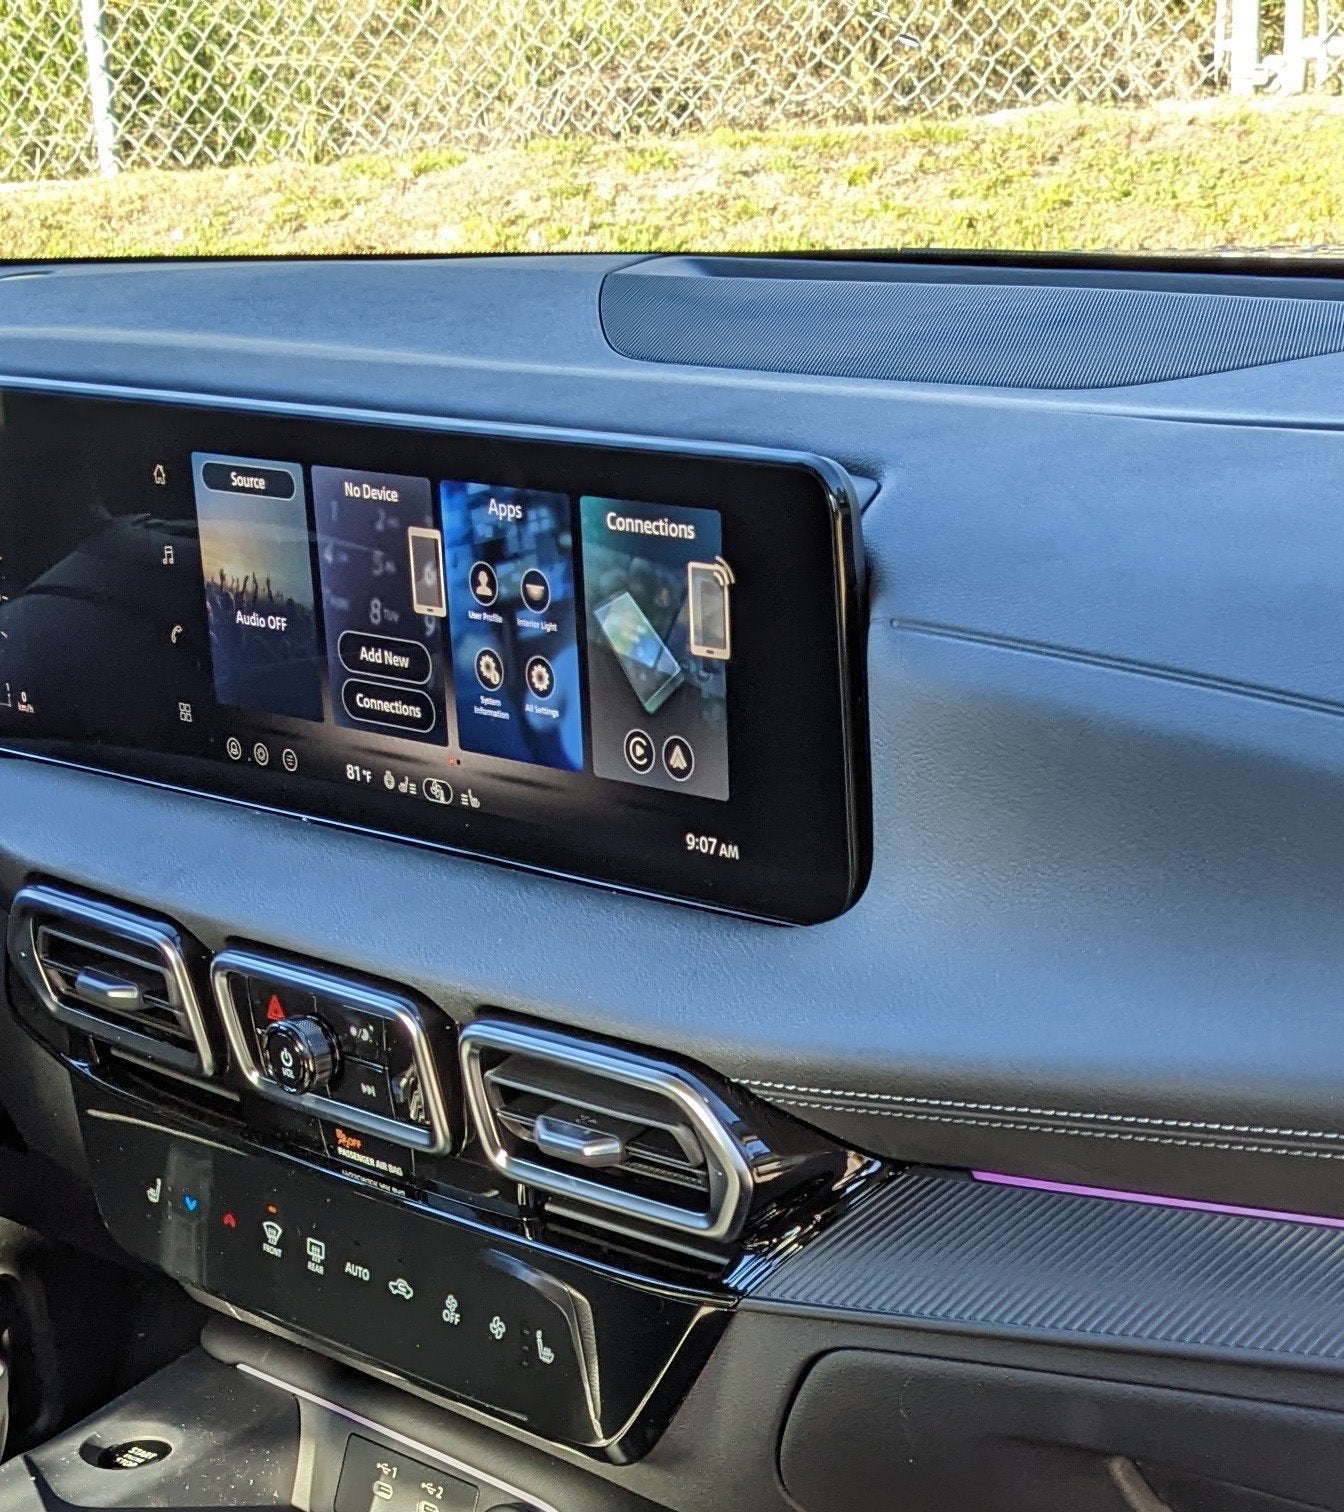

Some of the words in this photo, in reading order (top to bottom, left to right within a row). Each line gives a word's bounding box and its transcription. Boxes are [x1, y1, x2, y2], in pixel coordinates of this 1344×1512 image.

[230, 471, 266, 490] Source
[344, 482, 361, 498] No
[362, 483, 399, 503] Device
[488, 498, 523, 522] Apps
[606, 511, 697, 540] Connections
[236, 610, 266, 628] Audio
[267, 615, 288, 632] OFF
[468, 610, 482, 621] User
[483, 612, 503, 624] Profile
[516, 618, 539, 630] Interior
[540, 621, 558, 633] Light
[360, 646, 382, 664] Add
[384, 650, 410, 669] New
[356, 693, 423, 719] Connections
[480, 695, 502, 707] System
[474, 706, 510, 721] Information
[536, 704, 559, 718] Settings
[685, 832, 718, 857] 9:07
[719, 841, 740, 860] AM
[337, 1146, 375, 1168] PASSENGER
[375, 1159, 388, 1171] AIR
[388, 1163, 404, 1177] BAG
[262, 1243, 283, 1258] FRONT
[307, 1261, 324, 1275] REAR
[345, 1261, 370, 1281] AUTO
[442, 1309, 461, 1327] OFF
